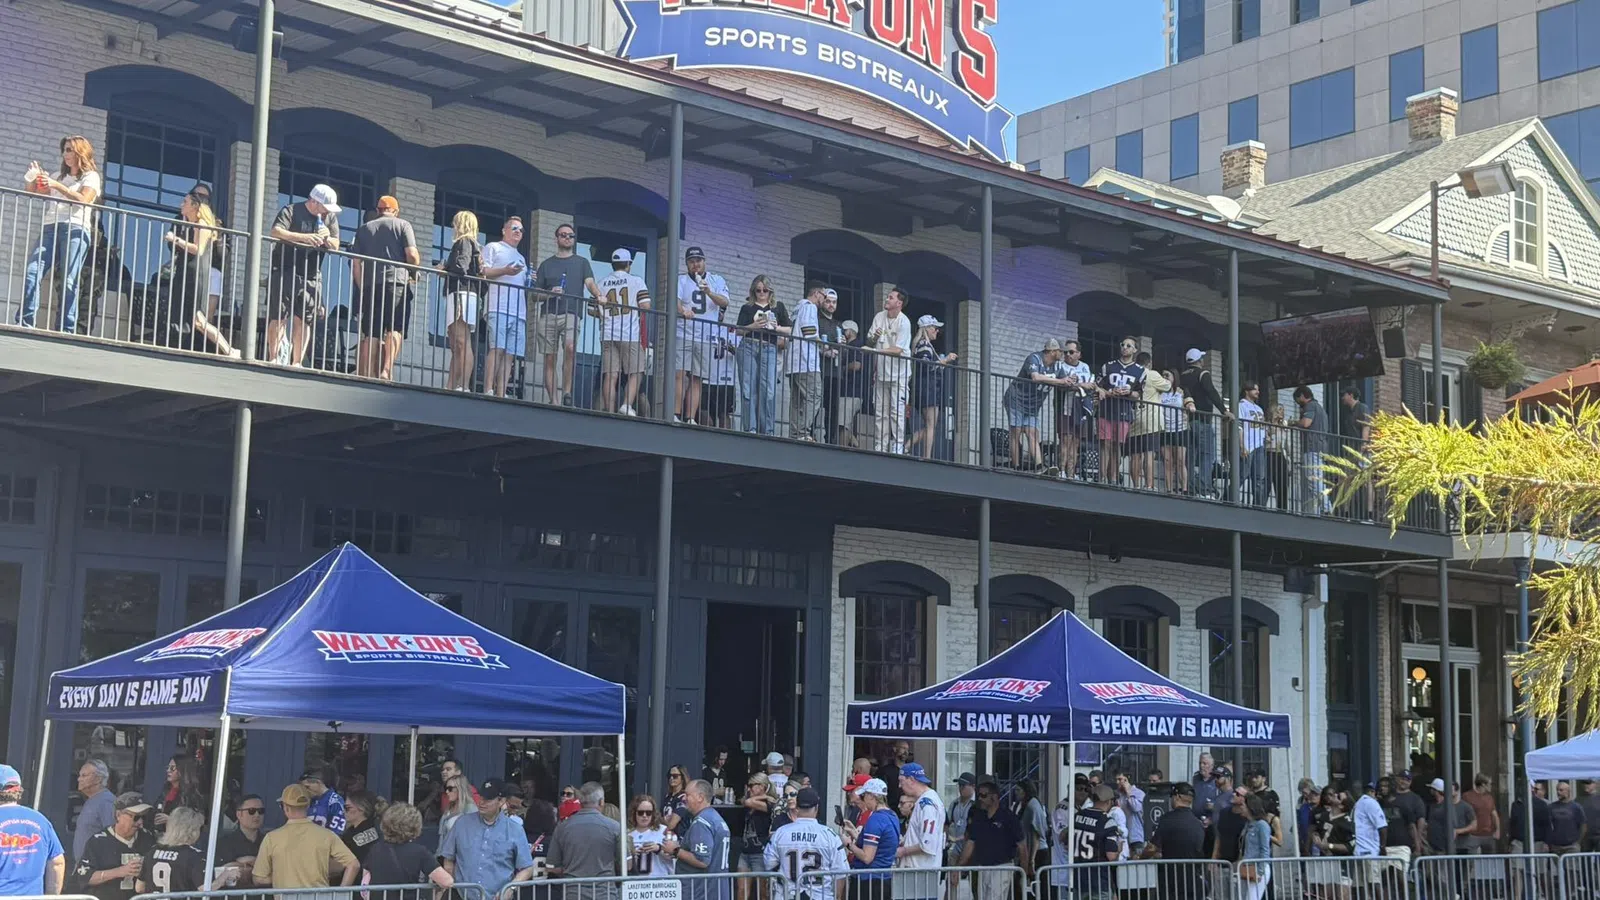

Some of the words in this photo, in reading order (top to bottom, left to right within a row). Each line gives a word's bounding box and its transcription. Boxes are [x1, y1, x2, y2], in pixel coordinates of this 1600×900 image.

[704, 27, 808, 56] SPORTS
[818, 43, 949, 117] BISTREAUX
[603, 278, 628, 287] KAMARA
[692, 290, 707, 315] 9
[405, 653, 473, 663] BISTREAUX
[59, 685, 98, 709] EVERY
[97, 682, 125, 708] DAY
[124, 681, 140, 707] IS
[140, 678, 179, 705] GAME
[180, 675, 211, 704] DAY
[861, 711, 908, 730] EVERY
[911, 712, 942, 731] DAY
[946, 712, 961, 731] IS
[966, 713, 1013, 733] GAME
[1017, 714, 1051, 734] DAY
[1090, 714, 1142, 735] EVERY
[1146, 716, 1177, 736] DAY
[1181, 717, 1196, 737] IS
[1200, 718, 1243, 739] GAME
[1246, 720, 1275, 740] DAY
[329, 815, 346, 832] 53
[923, 819, 936, 835] 11
[791, 832, 818, 843] BRADY
[153, 850, 179, 861] BREES
[785, 849, 823, 885] 12
[152, 861, 172, 897] 9
[628, 891, 639, 900] DO
[640, 890, 653, 899] NOT
[655, 890, 677, 899] CROSS
